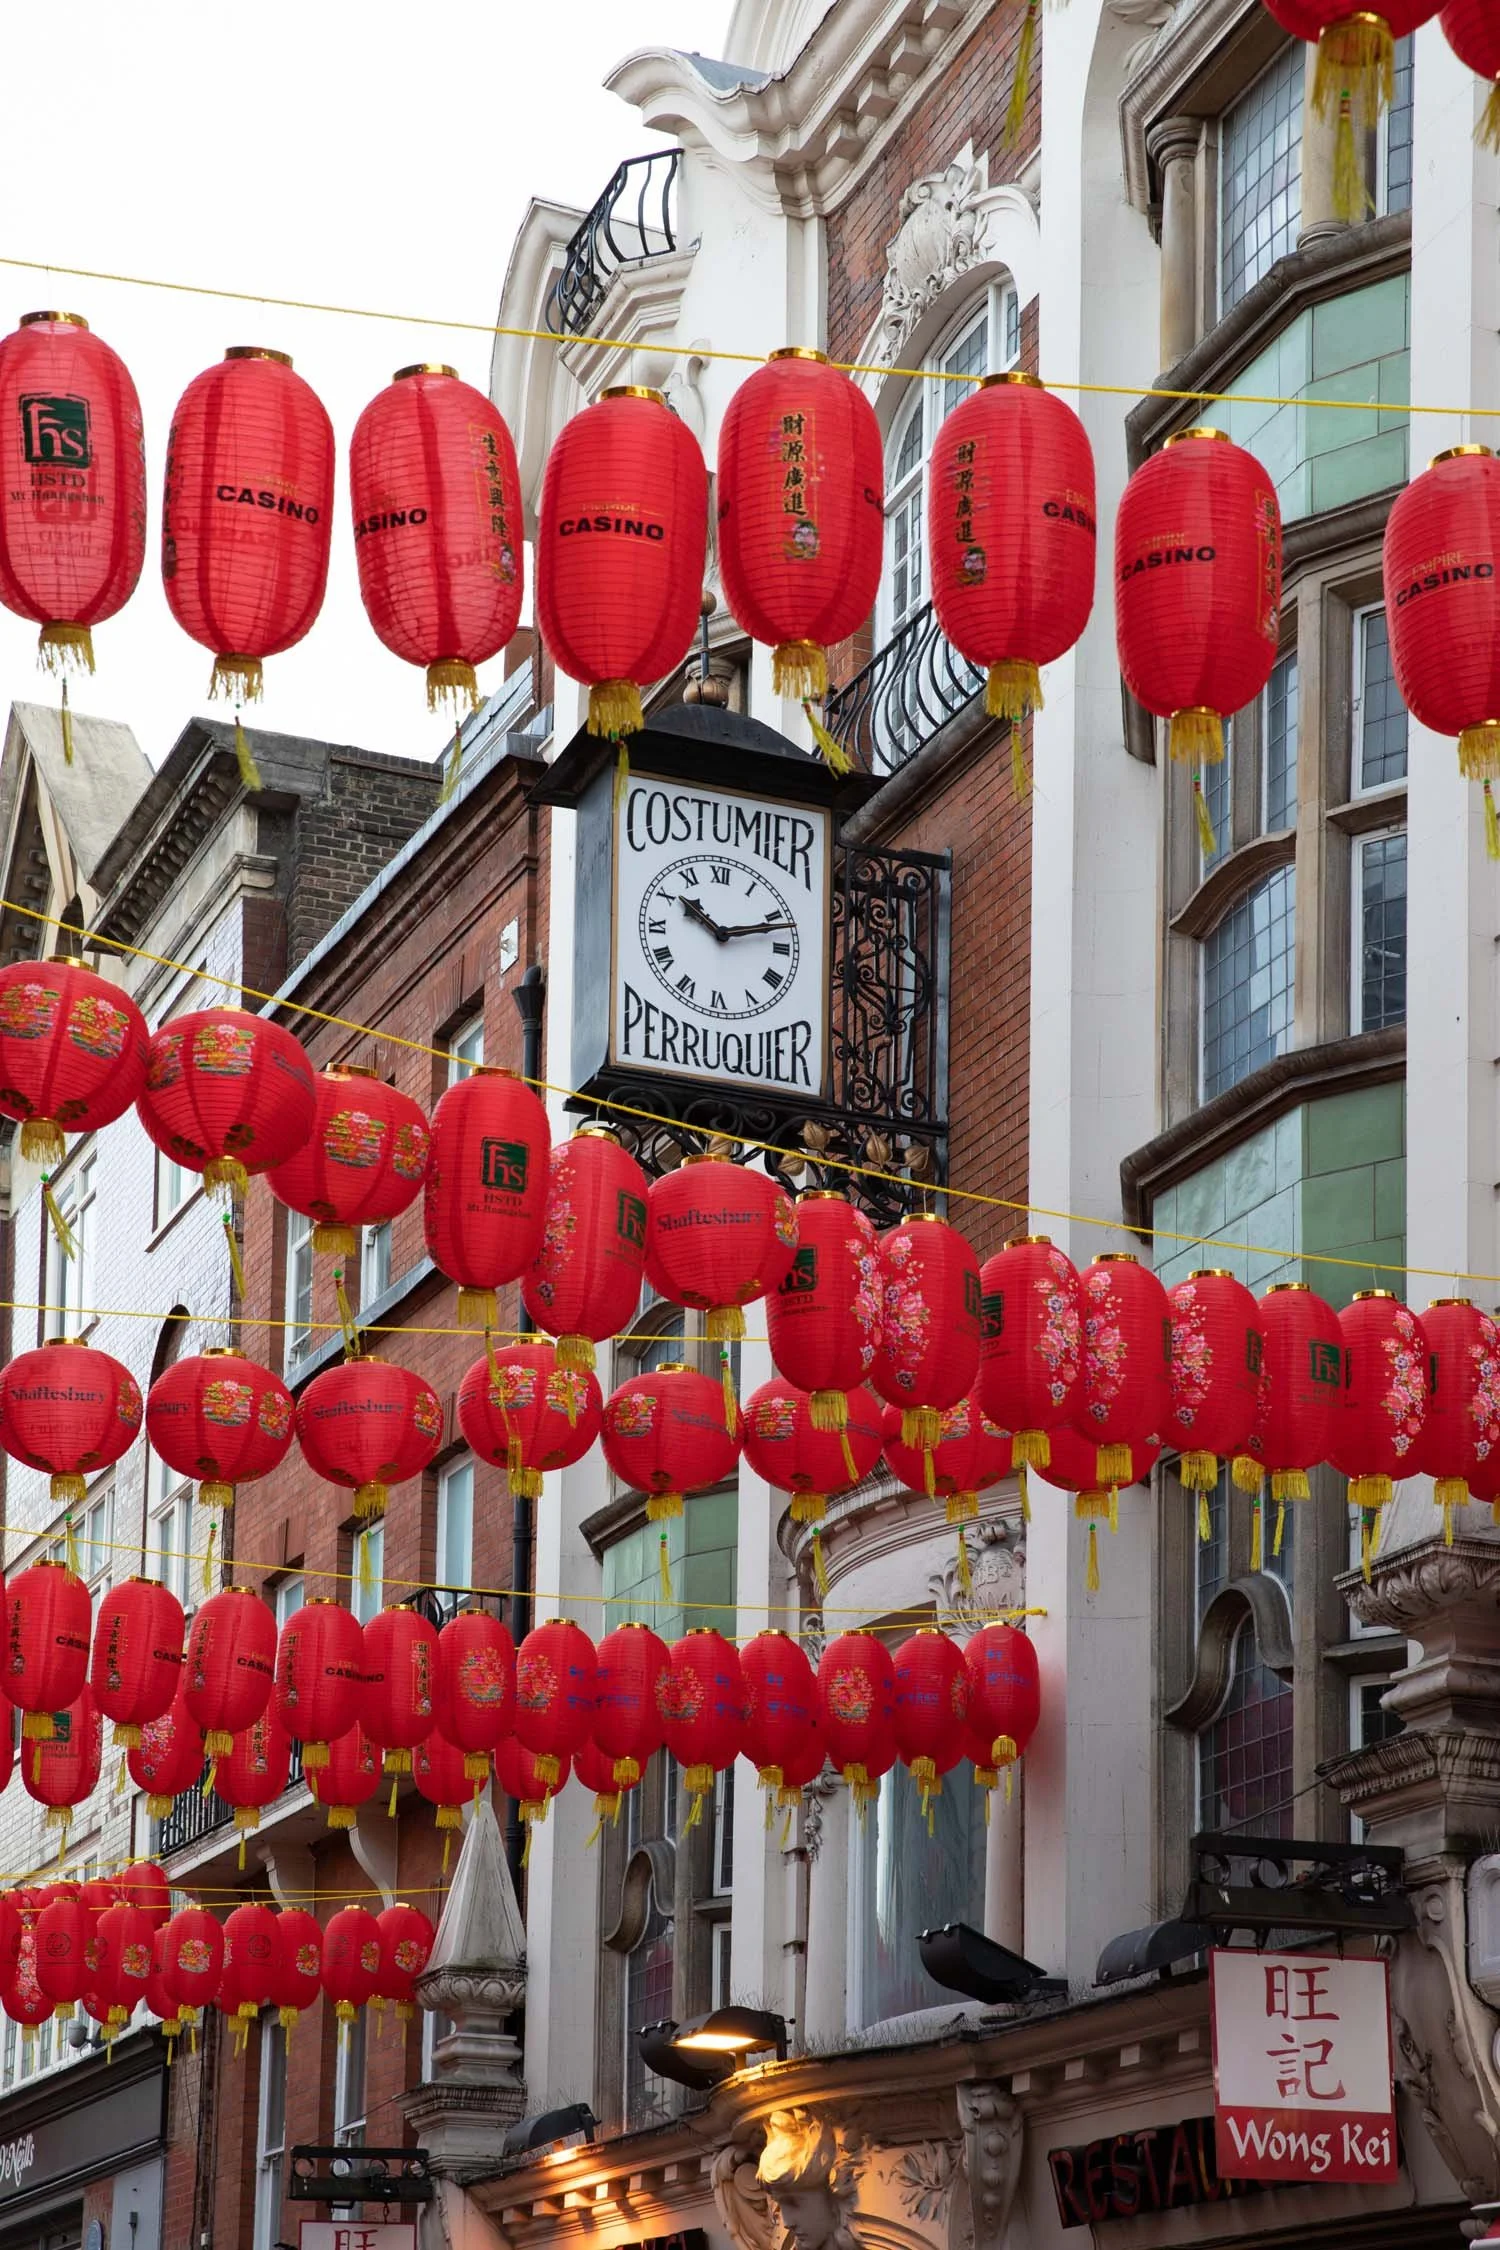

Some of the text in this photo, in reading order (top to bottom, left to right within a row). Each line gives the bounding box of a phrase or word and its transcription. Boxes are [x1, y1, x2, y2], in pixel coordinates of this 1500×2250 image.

[782, 413, 807, 516] 財源廣進
[216, 484, 320, 525] CASINO
[559, 516, 664, 541] CASINO
[1121, 546, 1216, 582] CASINO
[1396, 563, 1493, 607] CASINO
[626, 787, 815, 892] COSTUMIER
[622, 981, 813, 1088] PERRUQUIER
[657, 1206, 763, 1234] Shaftesbury
[1264, 1964, 1346, 2101] 旺記
[1050, 2118, 1240, 2226] RESTAU
[1226, 2116, 1391, 2173] Wong Kei
